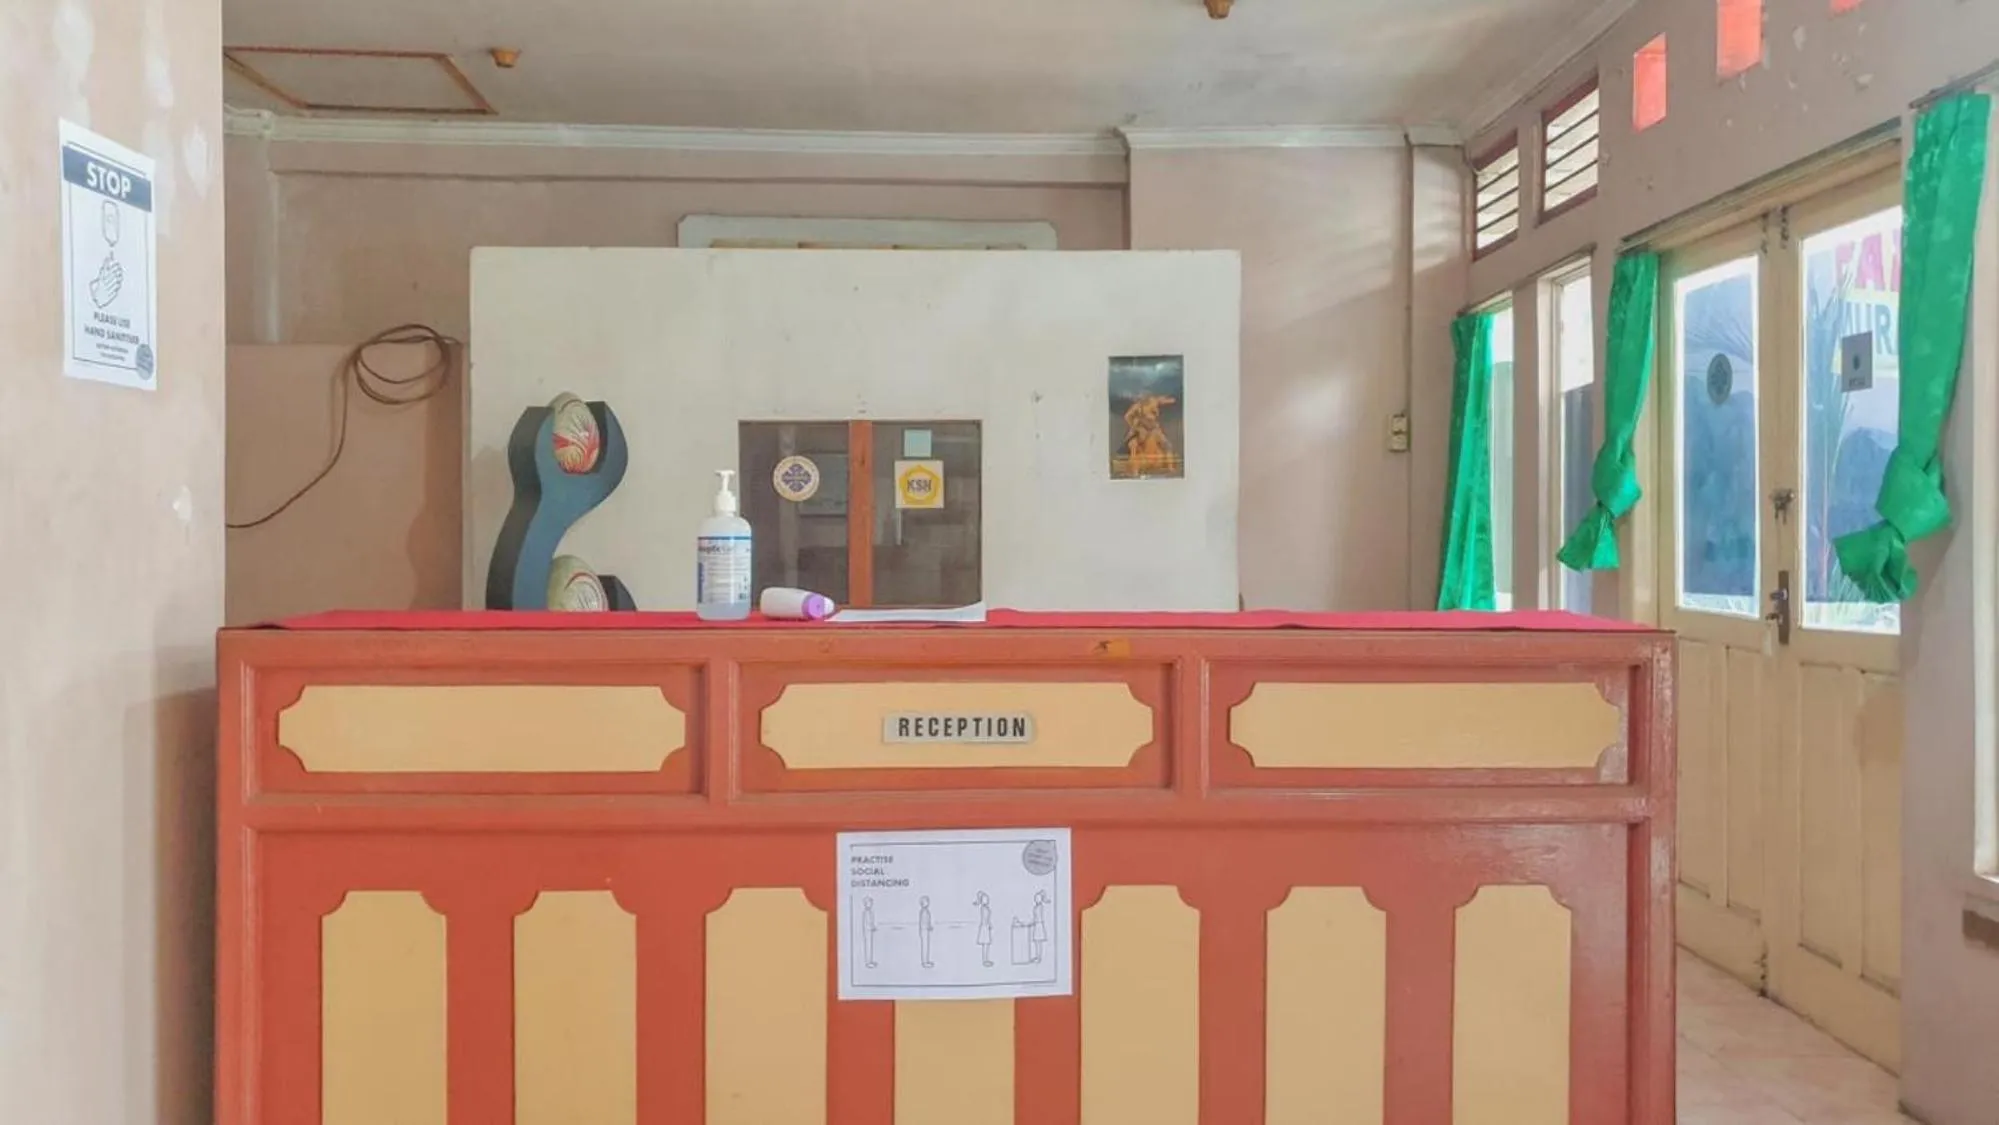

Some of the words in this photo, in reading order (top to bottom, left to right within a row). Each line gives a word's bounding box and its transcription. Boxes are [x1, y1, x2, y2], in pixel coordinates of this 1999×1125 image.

[86, 160, 131, 199] STOP
[898, 717, 1026, 738] RECEPTION
[851, 855, 894, 864] PRACTISE
[851, 867, 885, 876] SOCIAL
[851, 879, 910, 888] DISTANCING
